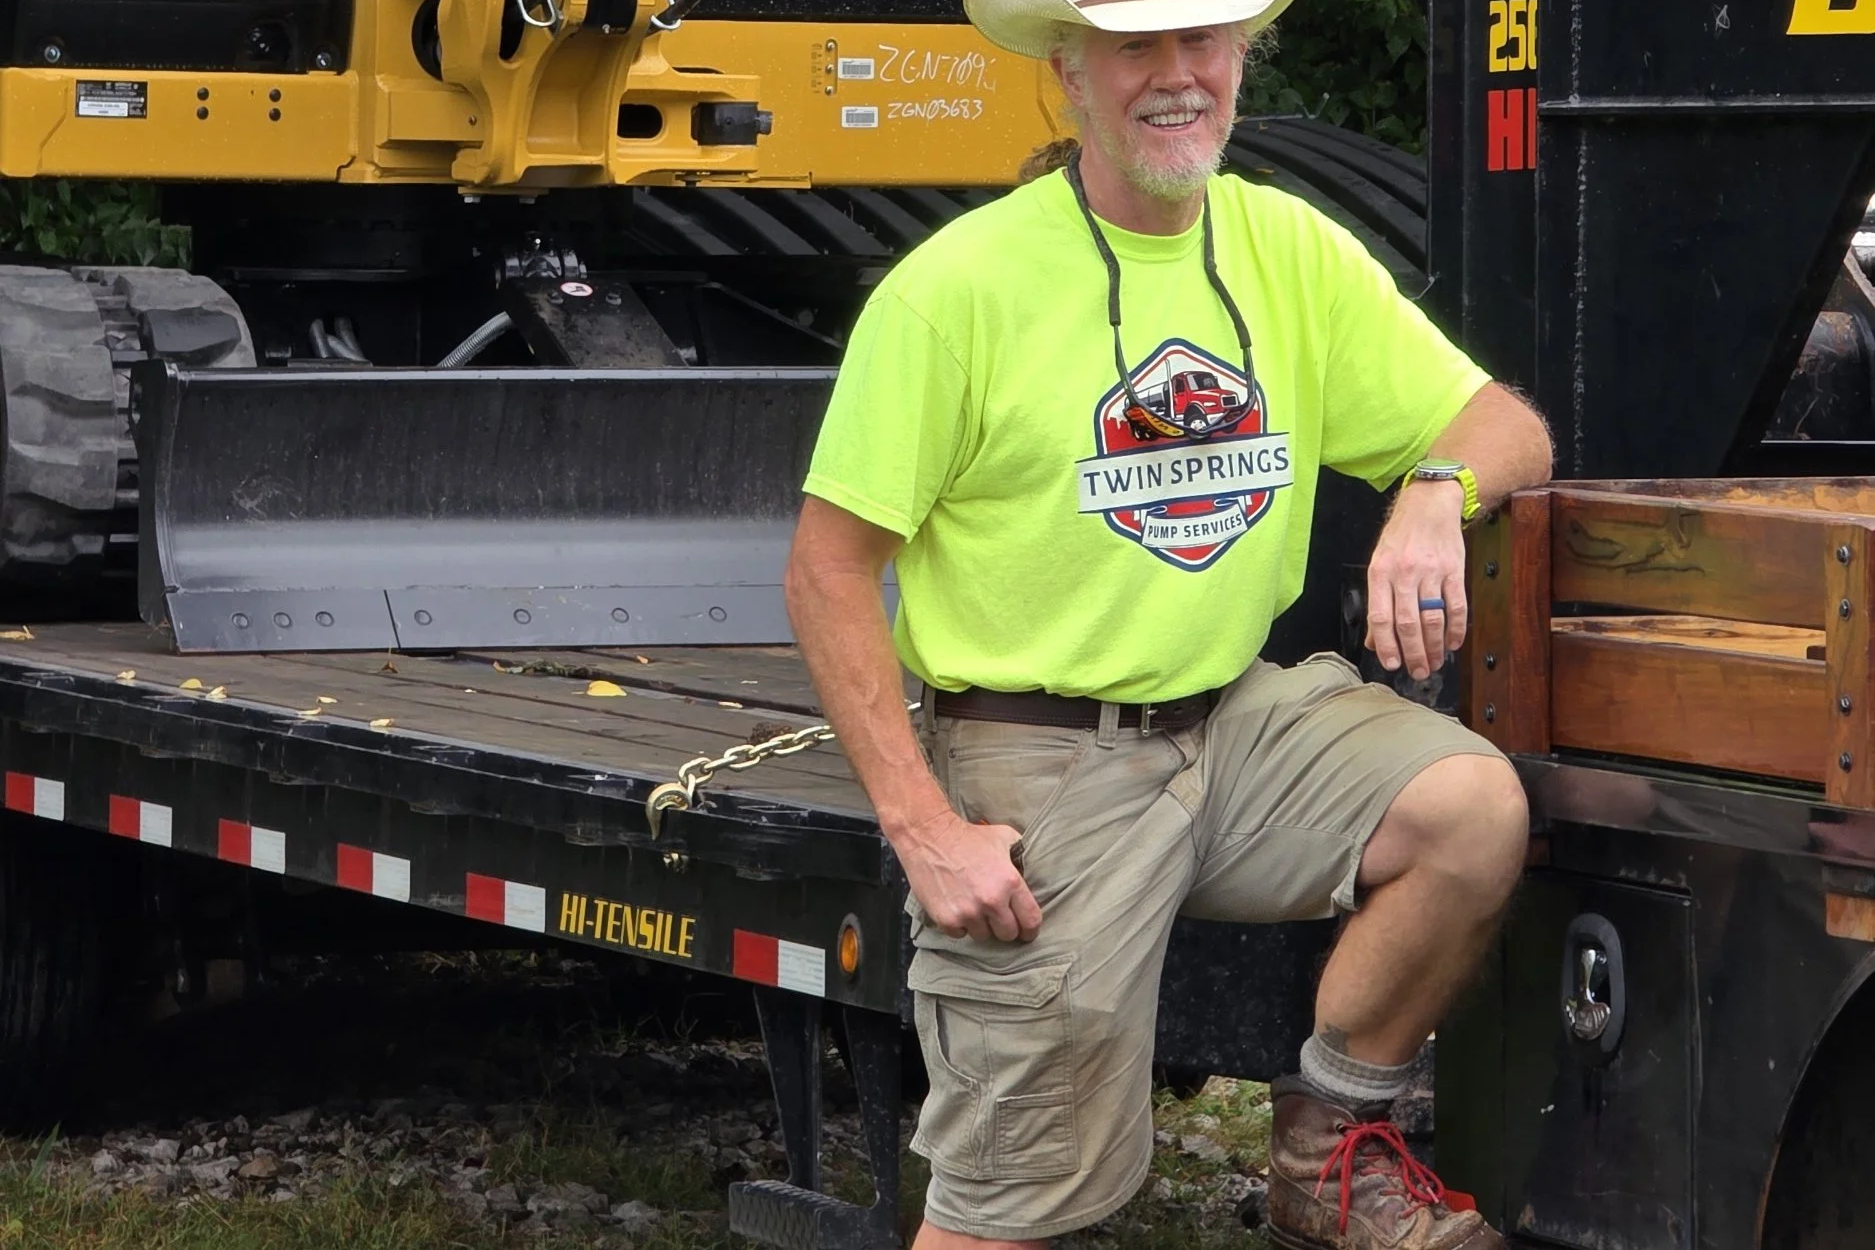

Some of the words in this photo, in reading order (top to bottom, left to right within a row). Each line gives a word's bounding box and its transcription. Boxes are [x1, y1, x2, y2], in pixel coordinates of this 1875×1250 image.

[1083, 462, 1162, 497] TWIN
[1170, 446, 1290, 485] SPRINGS
[1147, 524, 1179, 540] PUMP
[1183, 512, 1243, 538] SERVICES
[559, 893, 697, 958] HI-TENSILE
